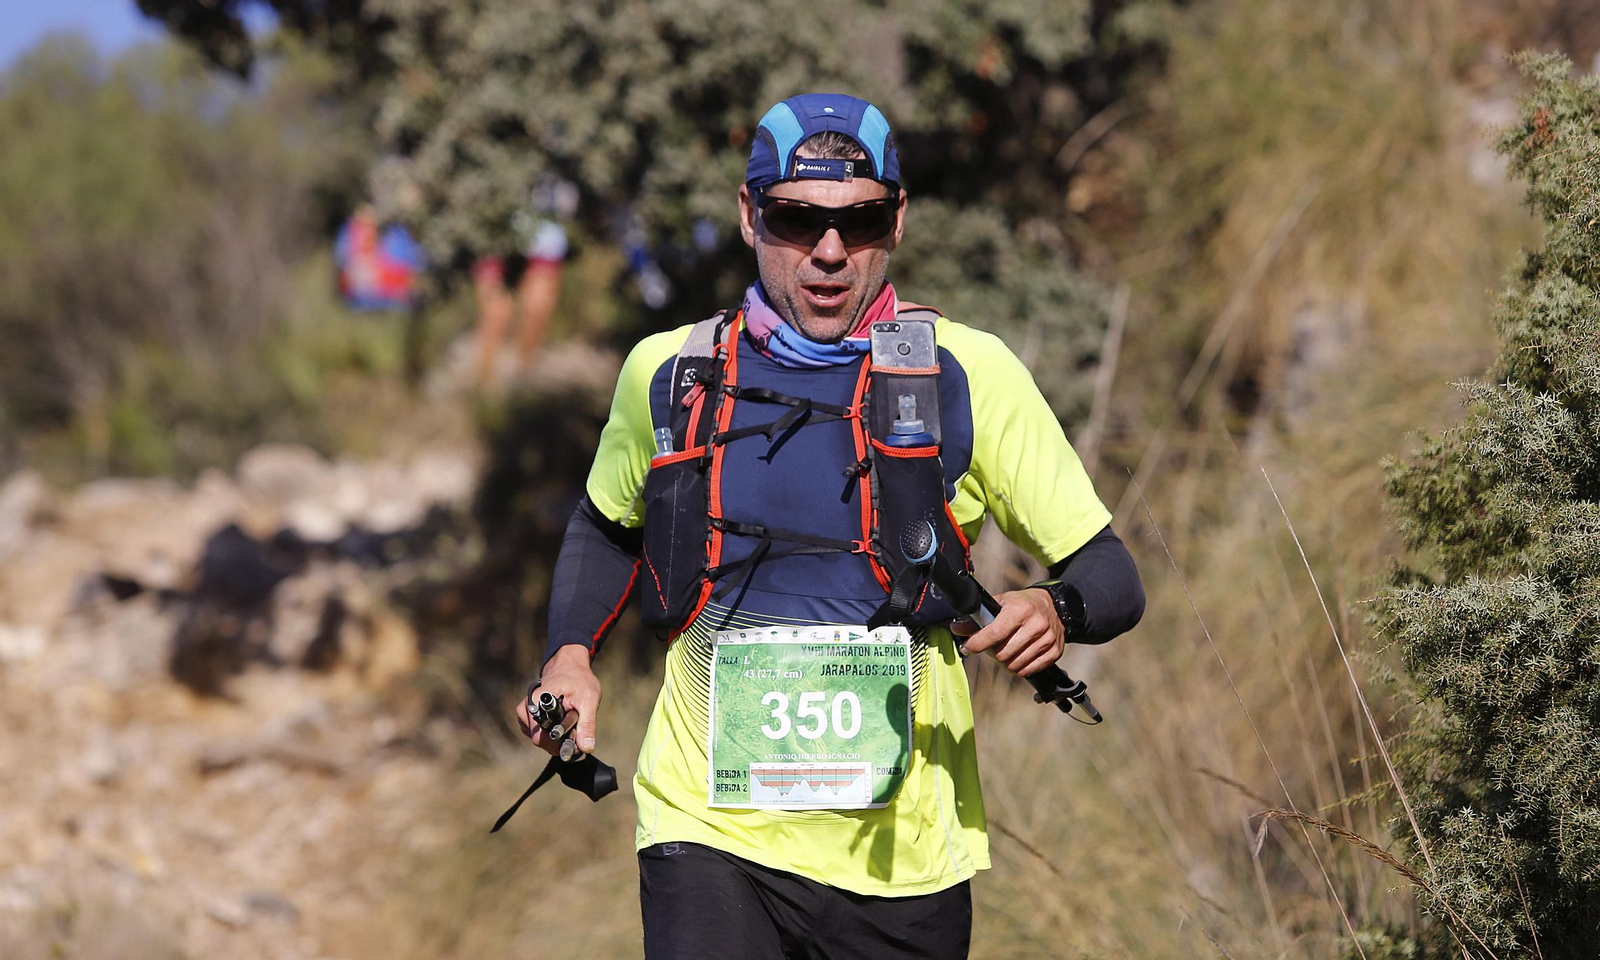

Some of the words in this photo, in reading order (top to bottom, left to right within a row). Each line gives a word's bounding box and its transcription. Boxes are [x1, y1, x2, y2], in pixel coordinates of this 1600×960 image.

[827, 646, 870, 657] MARATON
[873, 646, 905, 657] ALPINO
[744, 656, 751, 665] L
[744, 669, 754, 679] 43
[757, 669, 780, 680] (27,7
[784, 670, 803, 680] cm)
[820, 664, 878, 676] JARAPALOS
[882, 664, 906, 676] 2019
[760, 690, 862, 740] 350
[798, 752, 827, 760] HIERRO
[828, 752, 860, 760] IGNACIO
[716, 769, 741, 778] BEBIDA
[743, 770, 747, 778] 1
[716, 783, 741, 792] BEBIDA
[743, 784, 748, 792] 2
